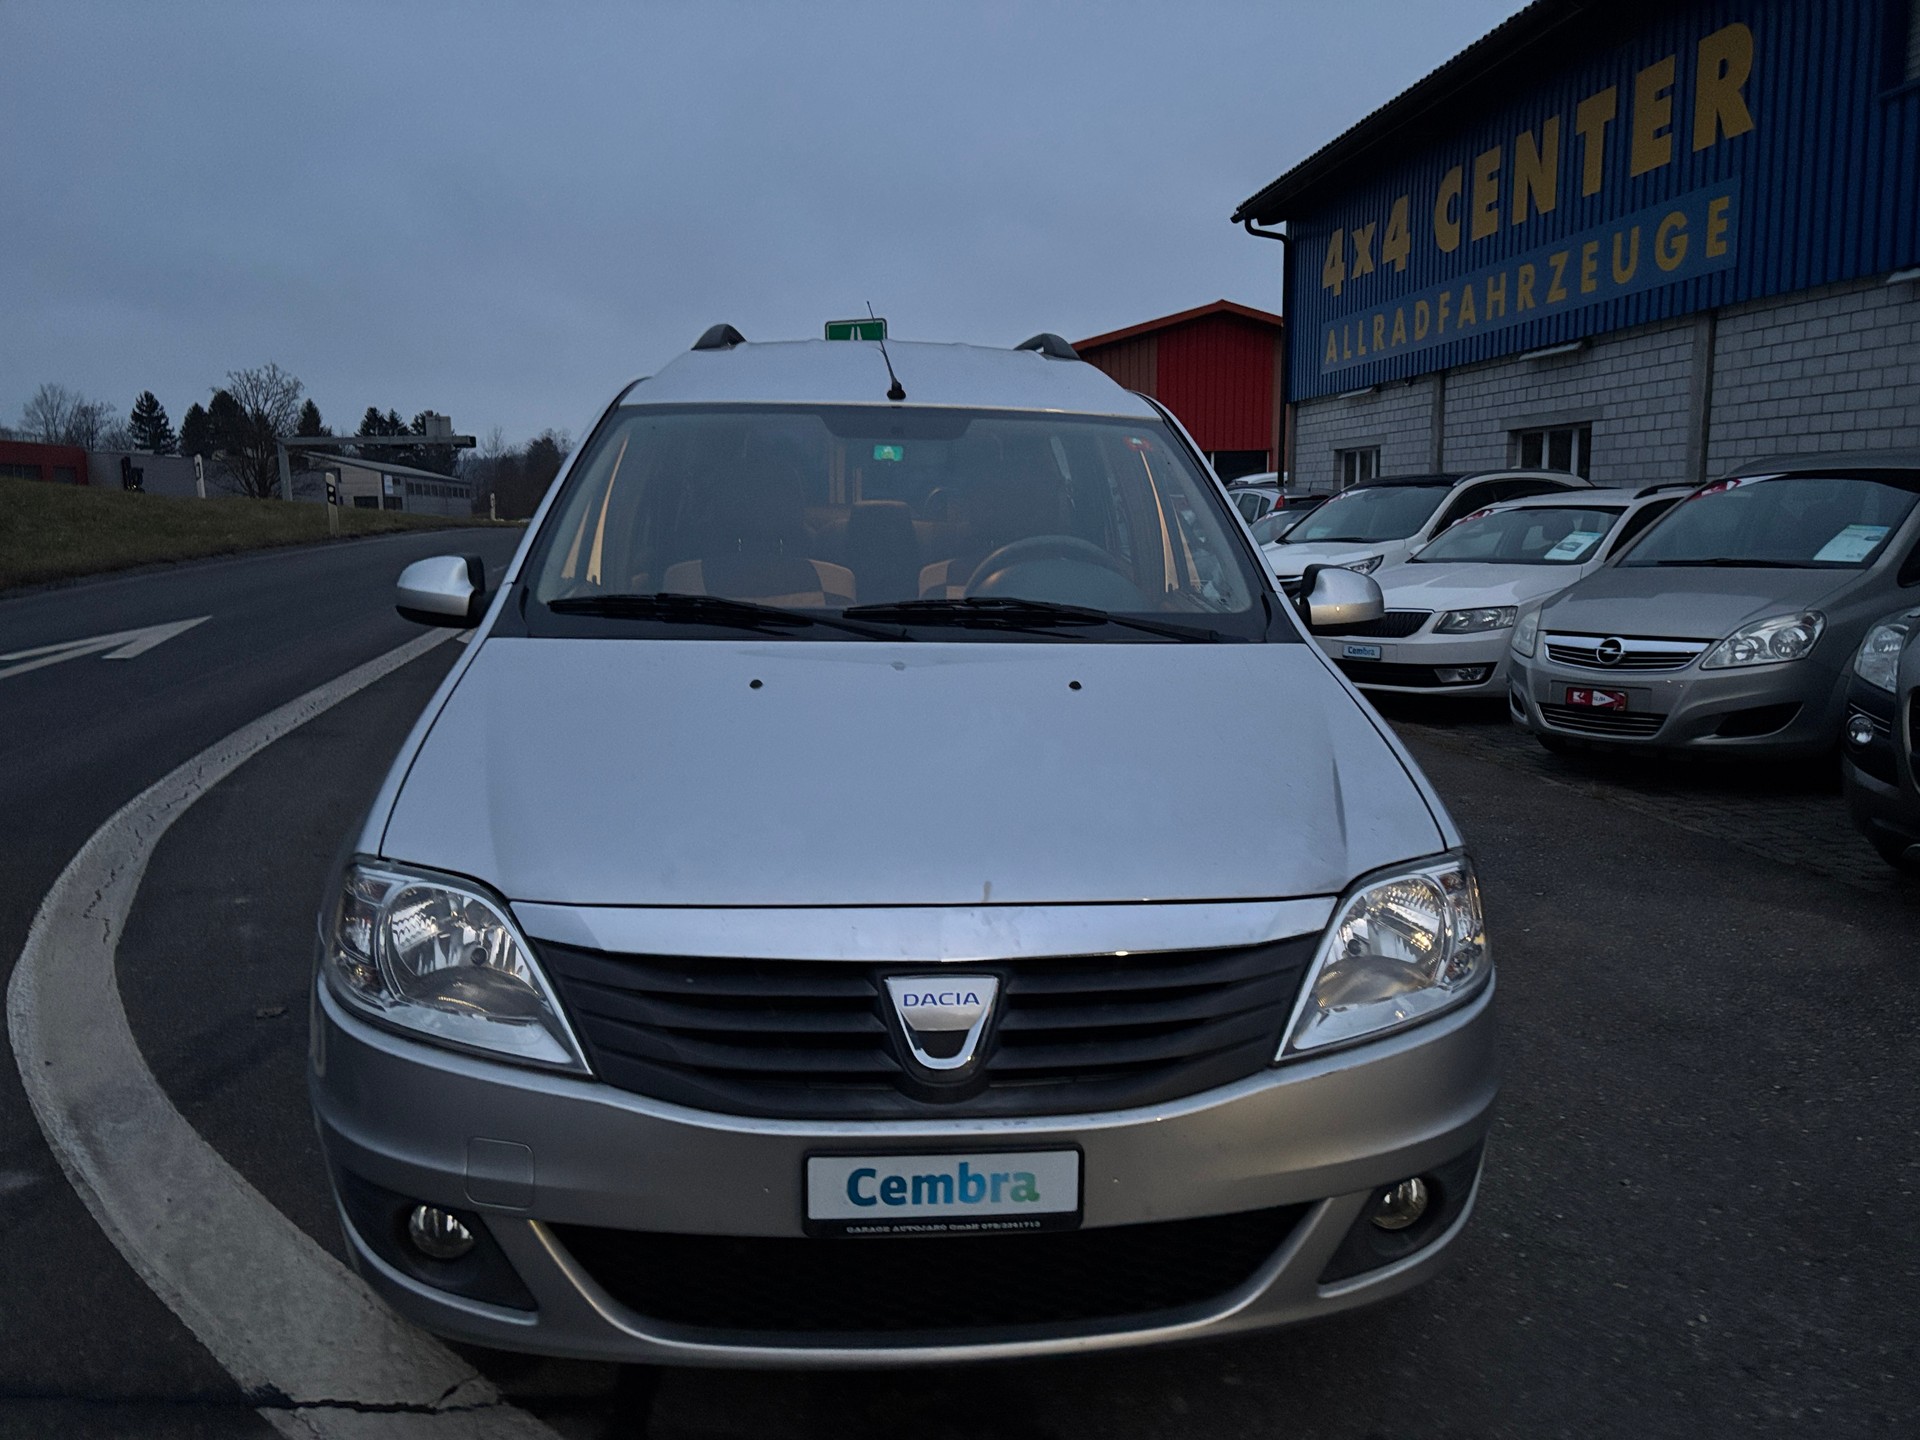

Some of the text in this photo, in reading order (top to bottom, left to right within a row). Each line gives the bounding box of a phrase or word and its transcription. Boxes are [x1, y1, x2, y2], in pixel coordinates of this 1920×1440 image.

[1321, 21, 1755, 298] 4x4 CENTER
[1325, 196, 1732, 365] ALLRADFAHRZEUGE
[1348, 646, 1375, 656] Cembra
[903, 992, 980, 1007] DACIA
[846, 1162, 1040, 1207] Cembra
